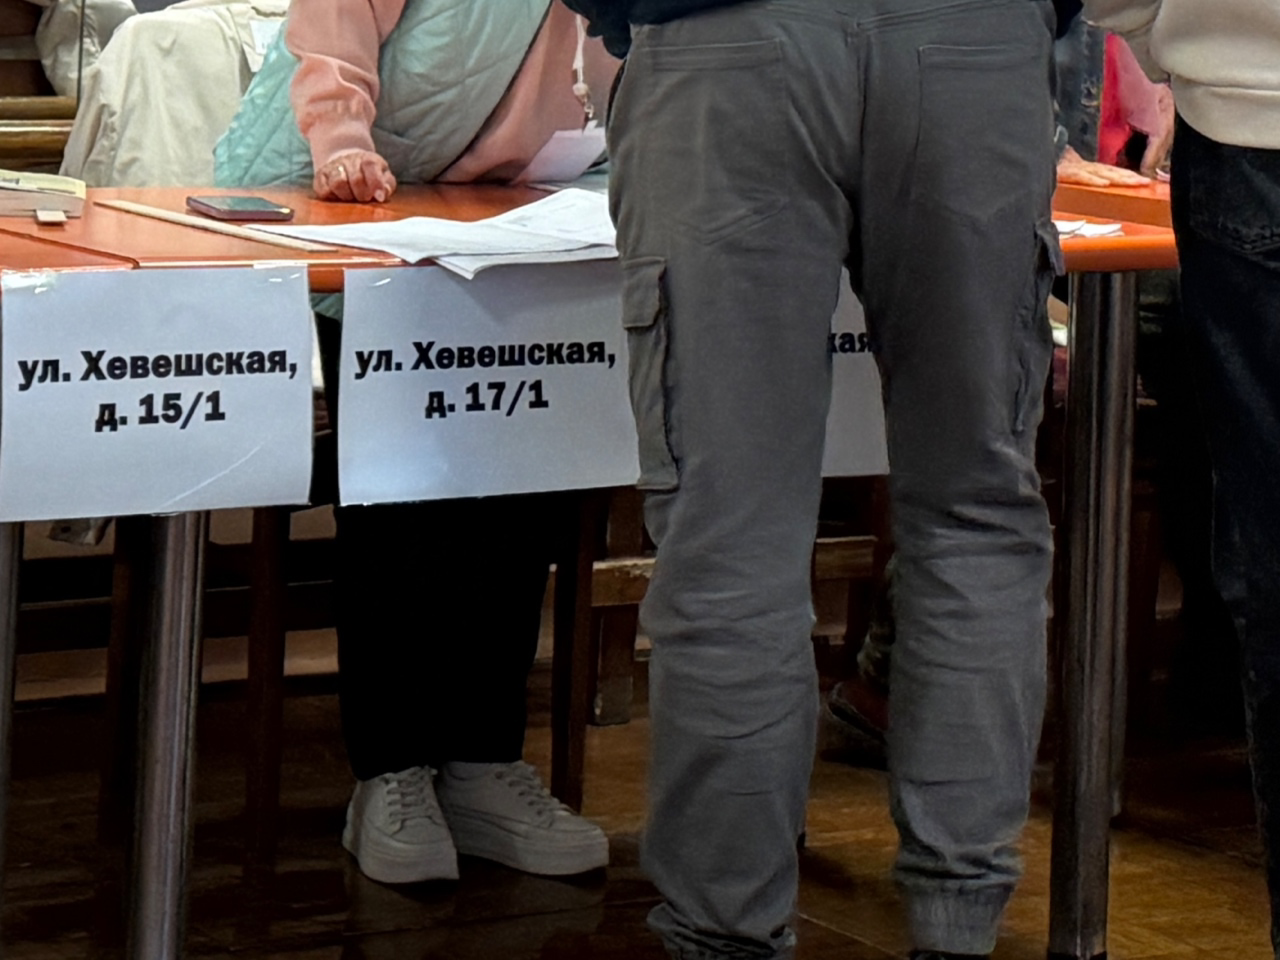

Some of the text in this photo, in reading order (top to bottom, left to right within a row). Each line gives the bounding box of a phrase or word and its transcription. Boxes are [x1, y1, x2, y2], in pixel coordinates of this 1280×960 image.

[18, 349, 298, 391] ул. Хевешская,
[354, 340, 616, 380] ул. Хевешская,
[95, 390, 226, 433] д. 15/1
[424, 379, 549, 419] д. 17/1
